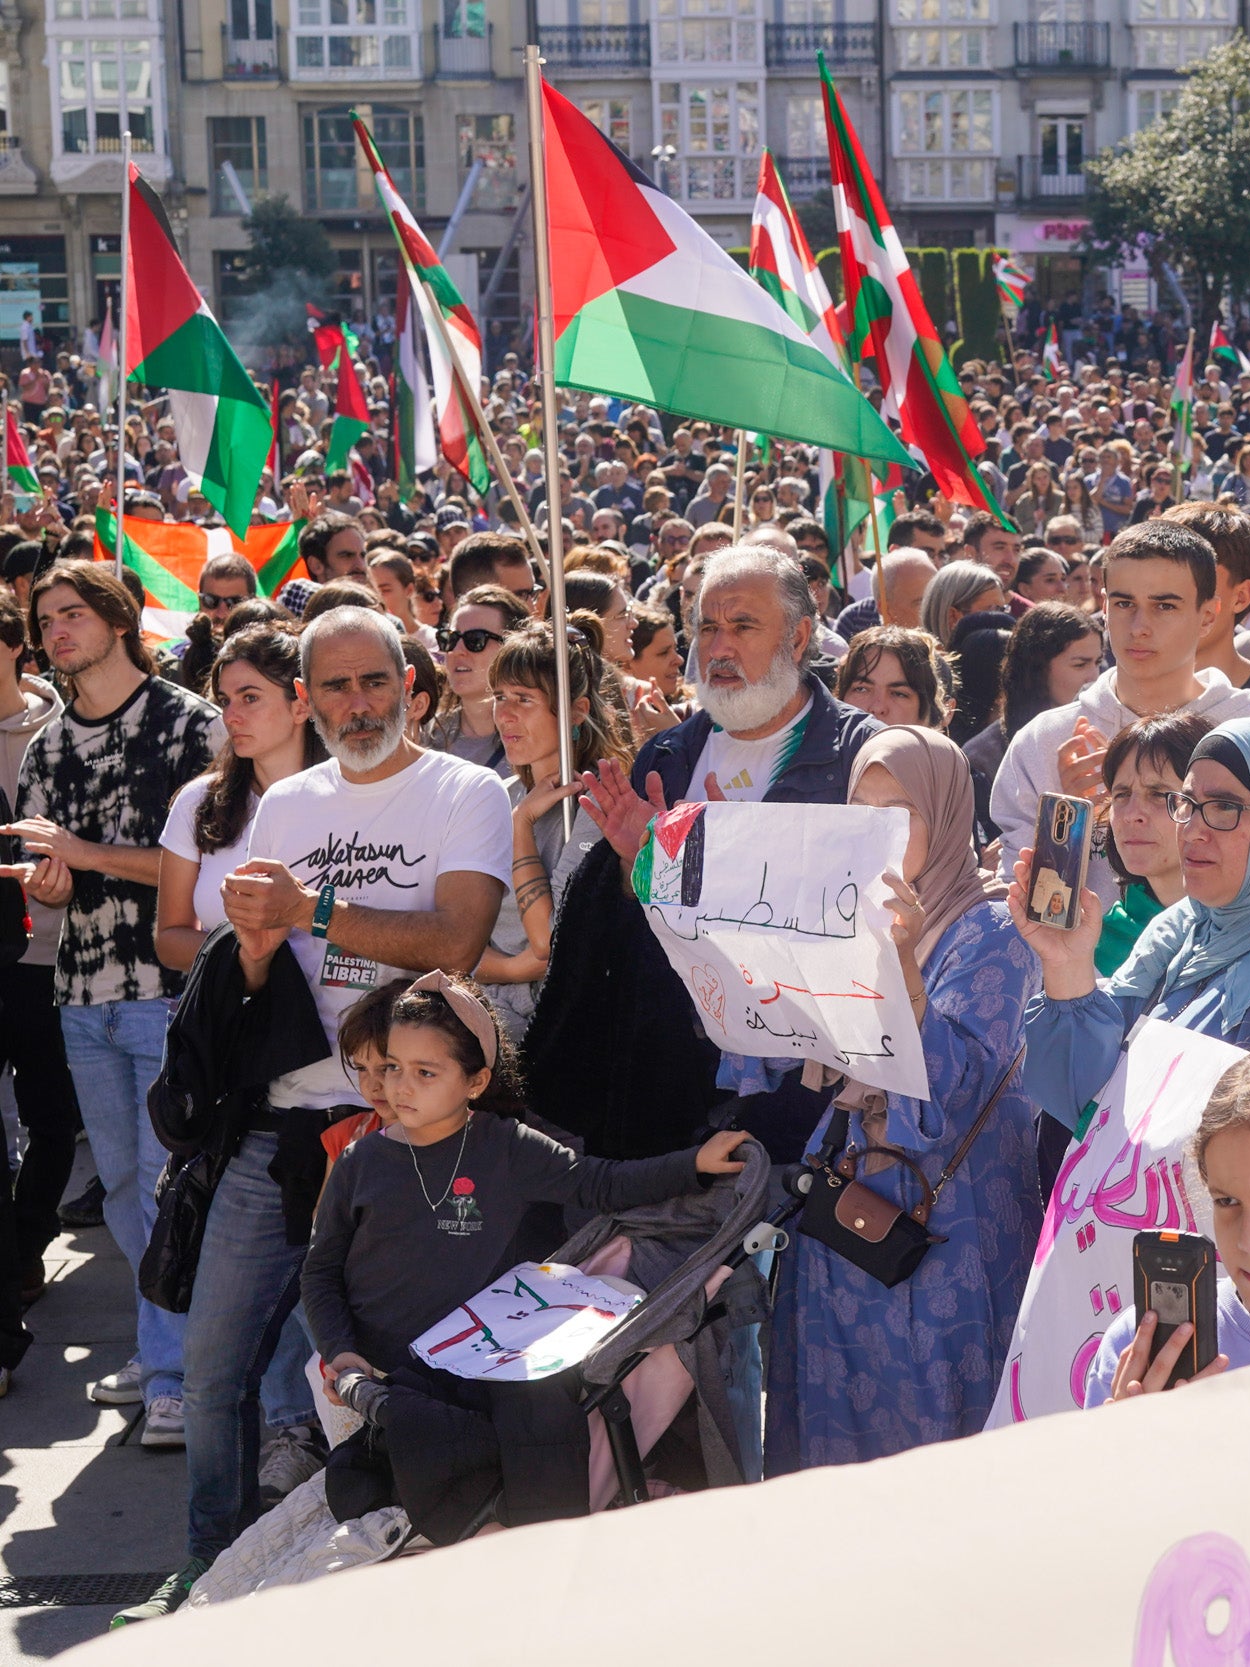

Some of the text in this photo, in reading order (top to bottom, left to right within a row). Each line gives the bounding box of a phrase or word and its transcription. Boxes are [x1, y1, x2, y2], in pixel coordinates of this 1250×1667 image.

[650, 862, 857, 941] فلسطين
[326, 954, 376, 968] PALESTINA
[322, 965, 377, 985] LIBRE!
[739, 964, 884, 1004] حرة
[437, 1219, 459, 1230] NEW
